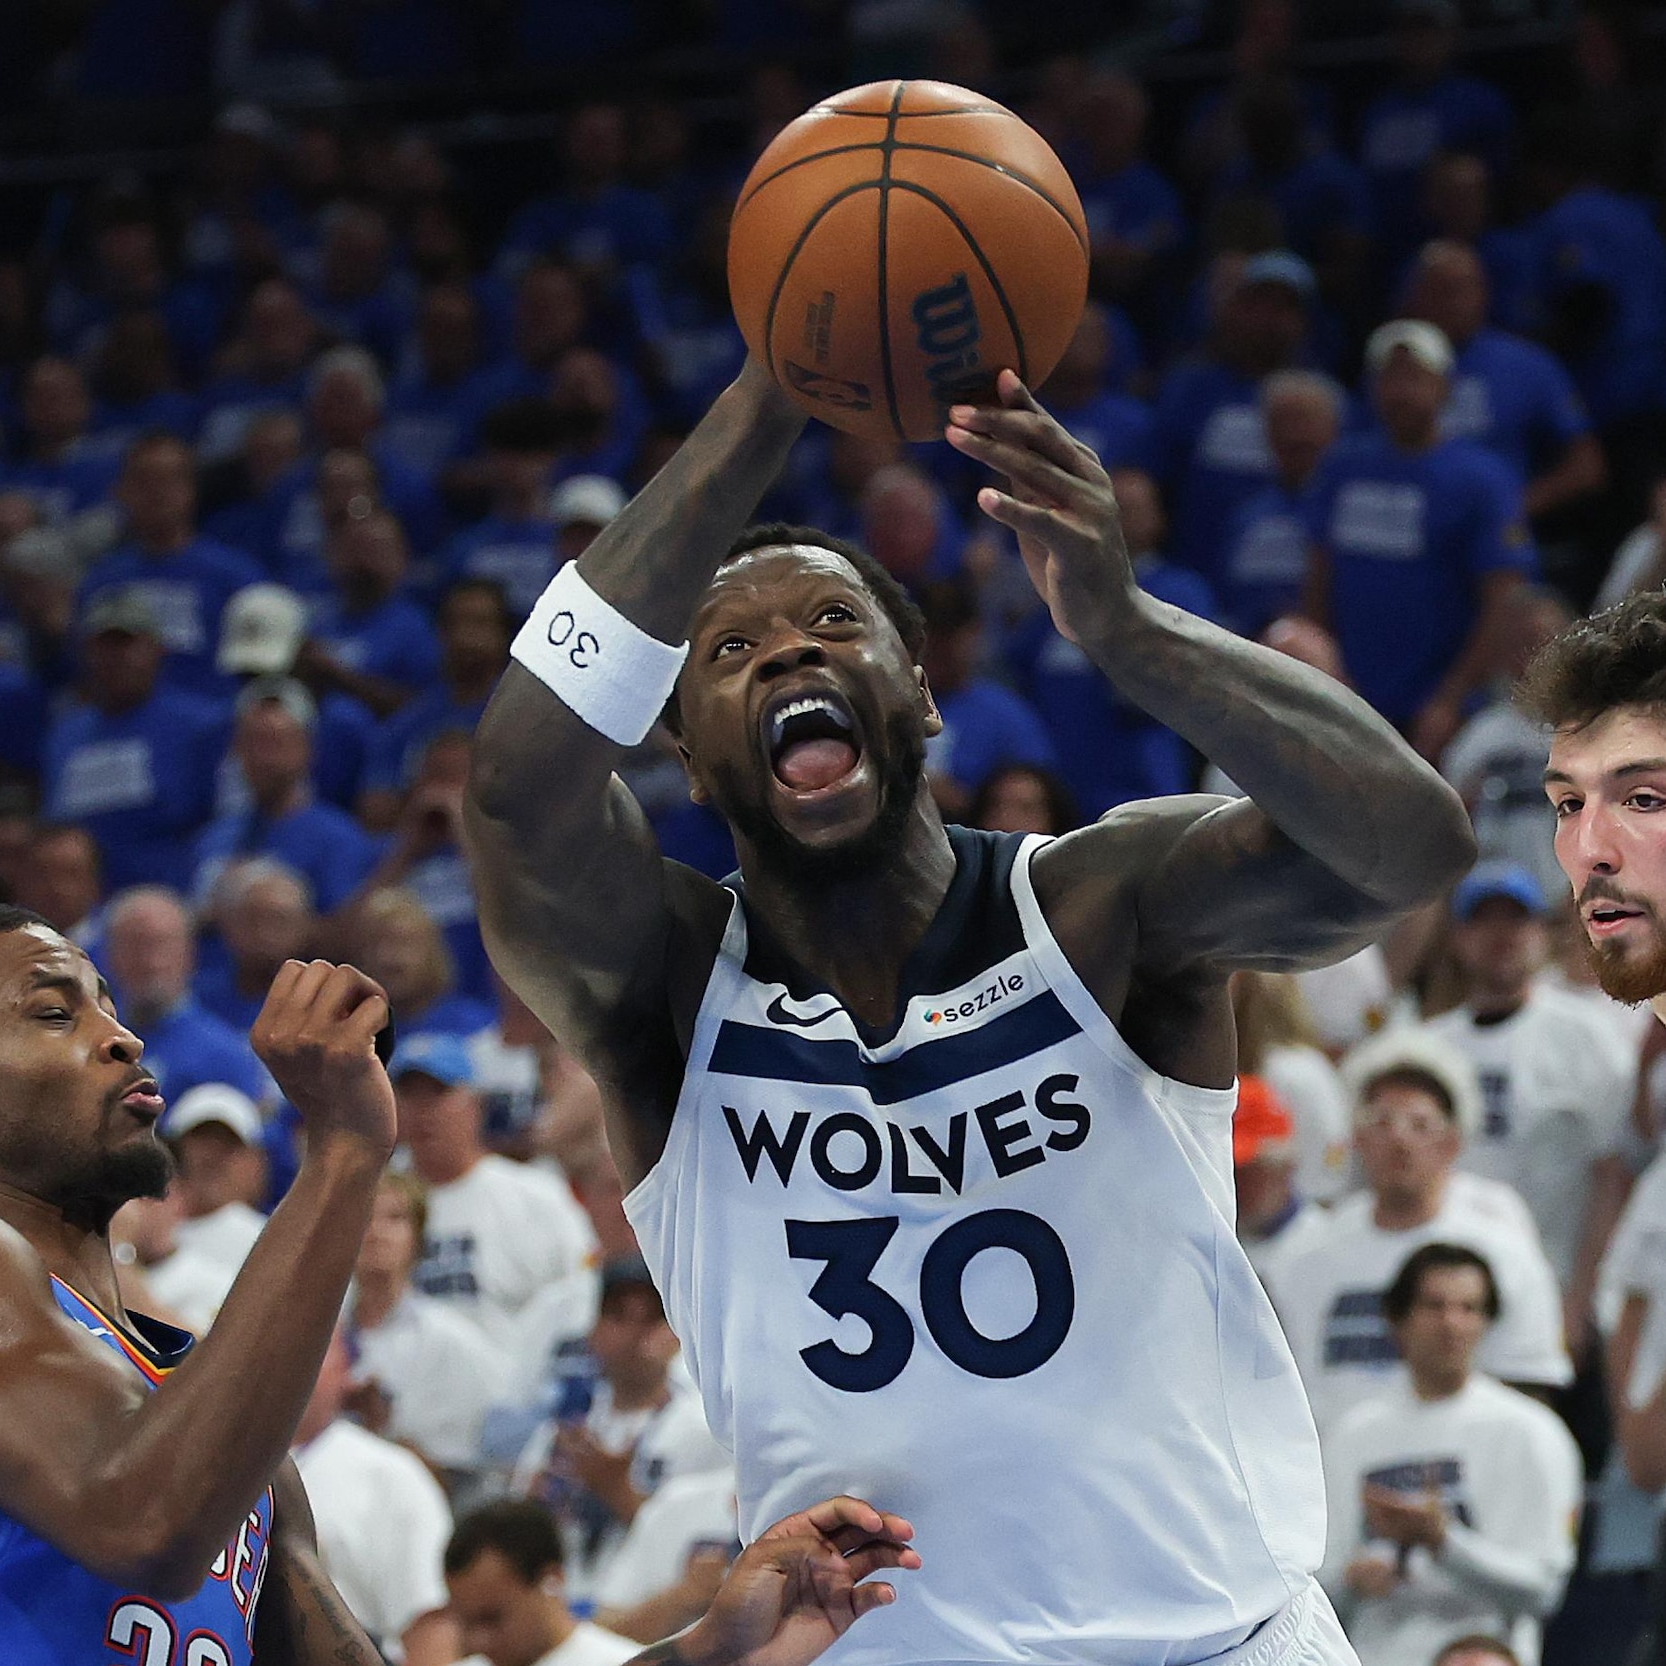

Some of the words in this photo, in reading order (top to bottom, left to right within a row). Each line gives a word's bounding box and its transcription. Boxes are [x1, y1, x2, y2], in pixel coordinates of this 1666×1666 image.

[546, 610, 600, 669] 30
[944, 973, 1024, 1022] sezzle
[721, 1072, 1092, 1196] WOLVES
[784, 1208, 1076, 1393] 30
